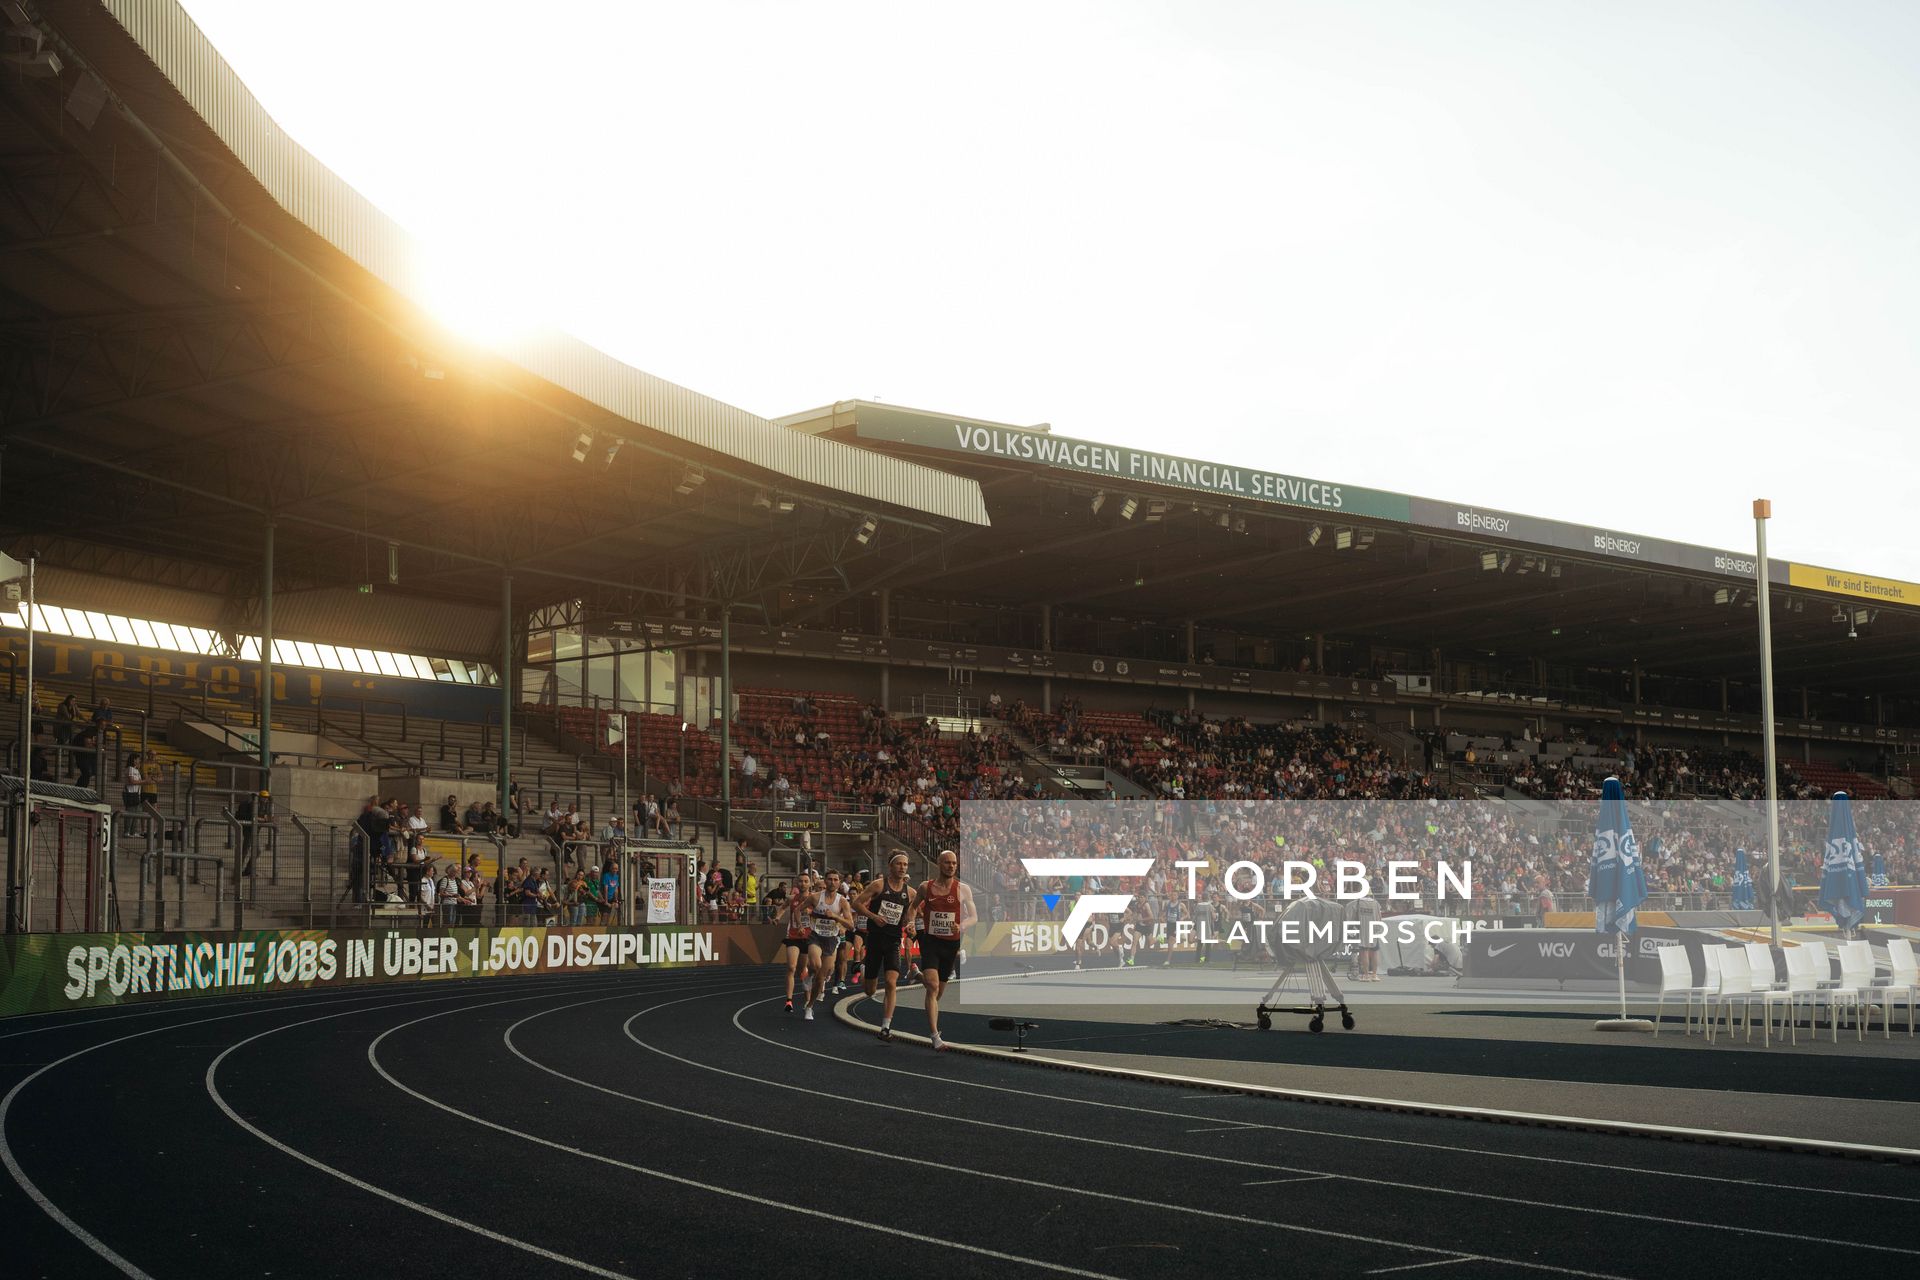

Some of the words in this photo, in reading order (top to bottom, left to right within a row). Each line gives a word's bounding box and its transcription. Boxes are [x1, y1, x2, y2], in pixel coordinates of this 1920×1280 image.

[955, 425, 1119, 472] VOLKSWAGEN
[1130, 453, 1244, 492] FINANCIAL
[1251, 473, 1343, 508] SERVICES
[1826, 574, 1841, 588] Wir
[1843, 577, 1862, 592] sind
[1864, 582, 1905, 599] Eintracht.
[688, 857, 695, 875] 5
[1537, 941, 1575, 958] WGV
[64, 943, 255, 1000] SPORTLICHE
[263, 938, 338, 984] JOBS
[345, 938, 375, 979] IN
[382, 930, 459, 977] ÜBER
[468, 934, 539, 972] 1.500
[546, 931, 720, 969] DISZIPLINEN.
